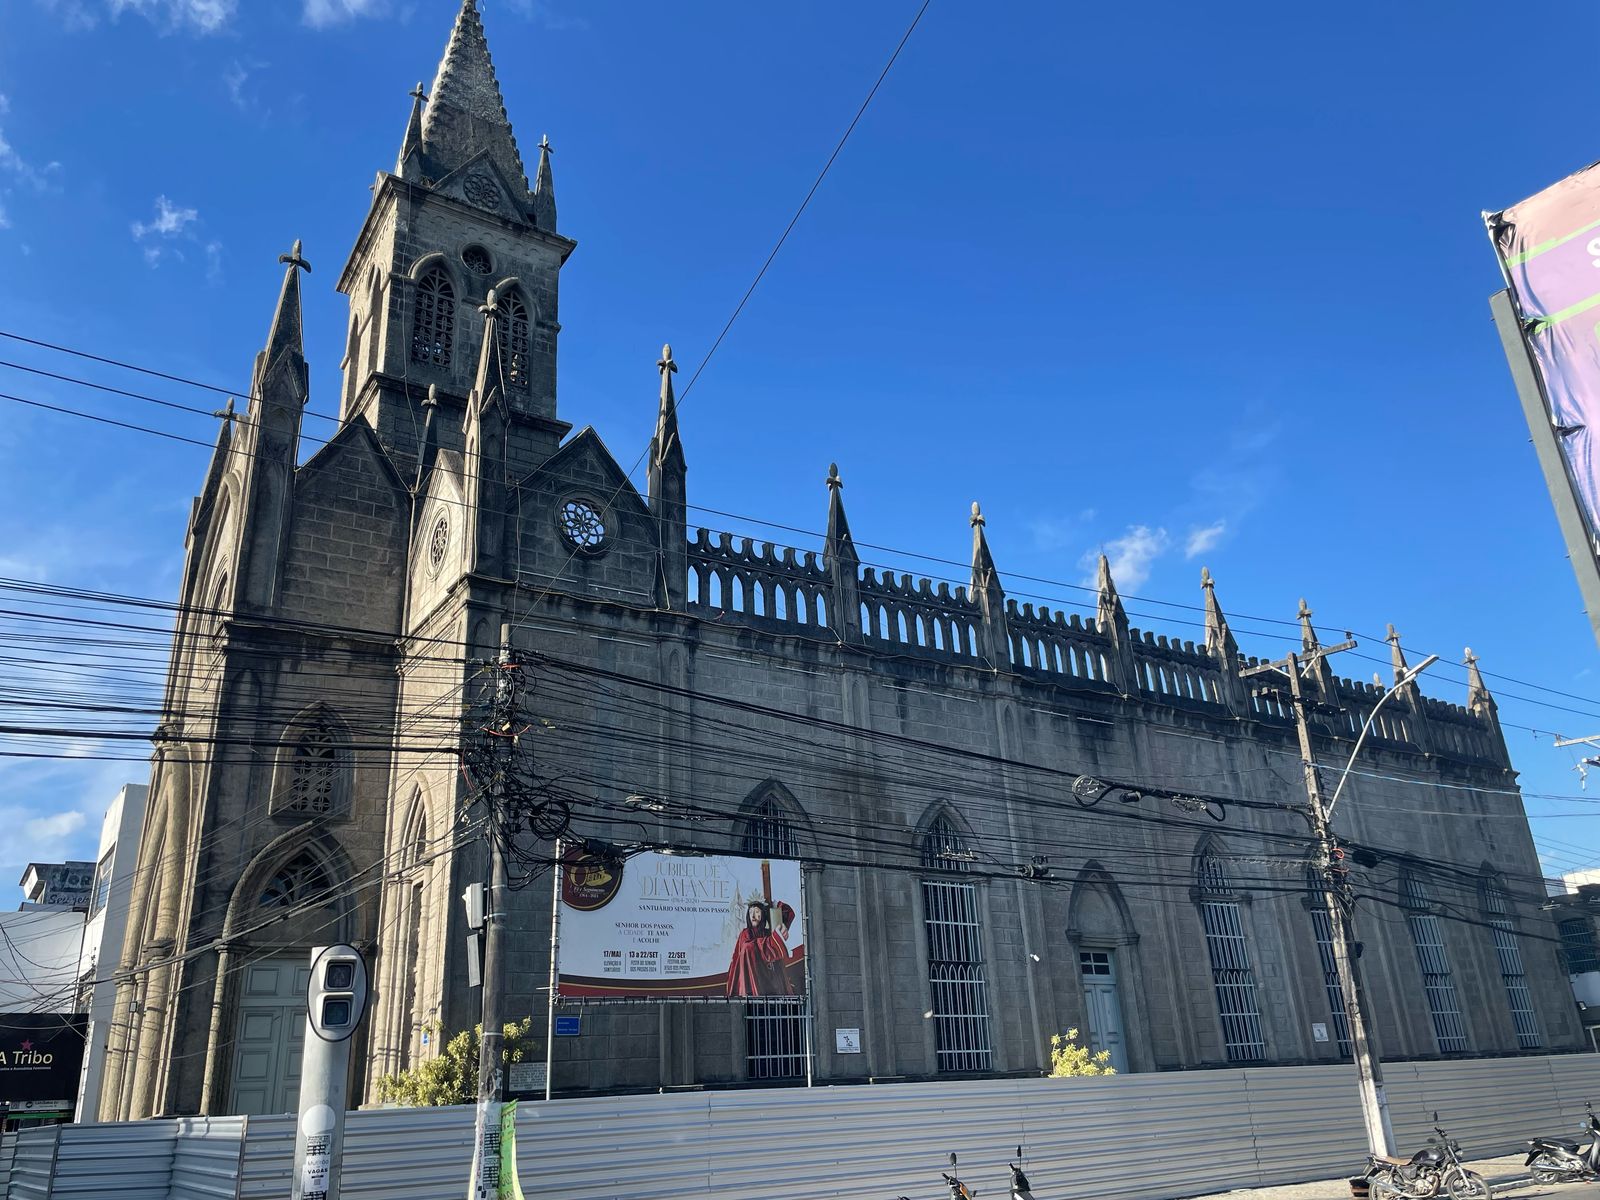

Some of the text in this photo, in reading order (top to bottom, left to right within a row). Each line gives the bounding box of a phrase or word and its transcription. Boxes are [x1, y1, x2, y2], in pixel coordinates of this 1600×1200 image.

[655, 861, 720, 878] JUBILEU DE
[641, 876, 730, 899] DIAMANTE
[638, 904, 673, 912] SANTUÁRIO
[674, 905, 698, 913] SENHOR
[603, 950, 622, 958] 17/MAI
[640, 951, 658, 959] 22/SET
[668, 951, 686, 959] 22/SET
[12, 1050, 53, 1065] Tribo
